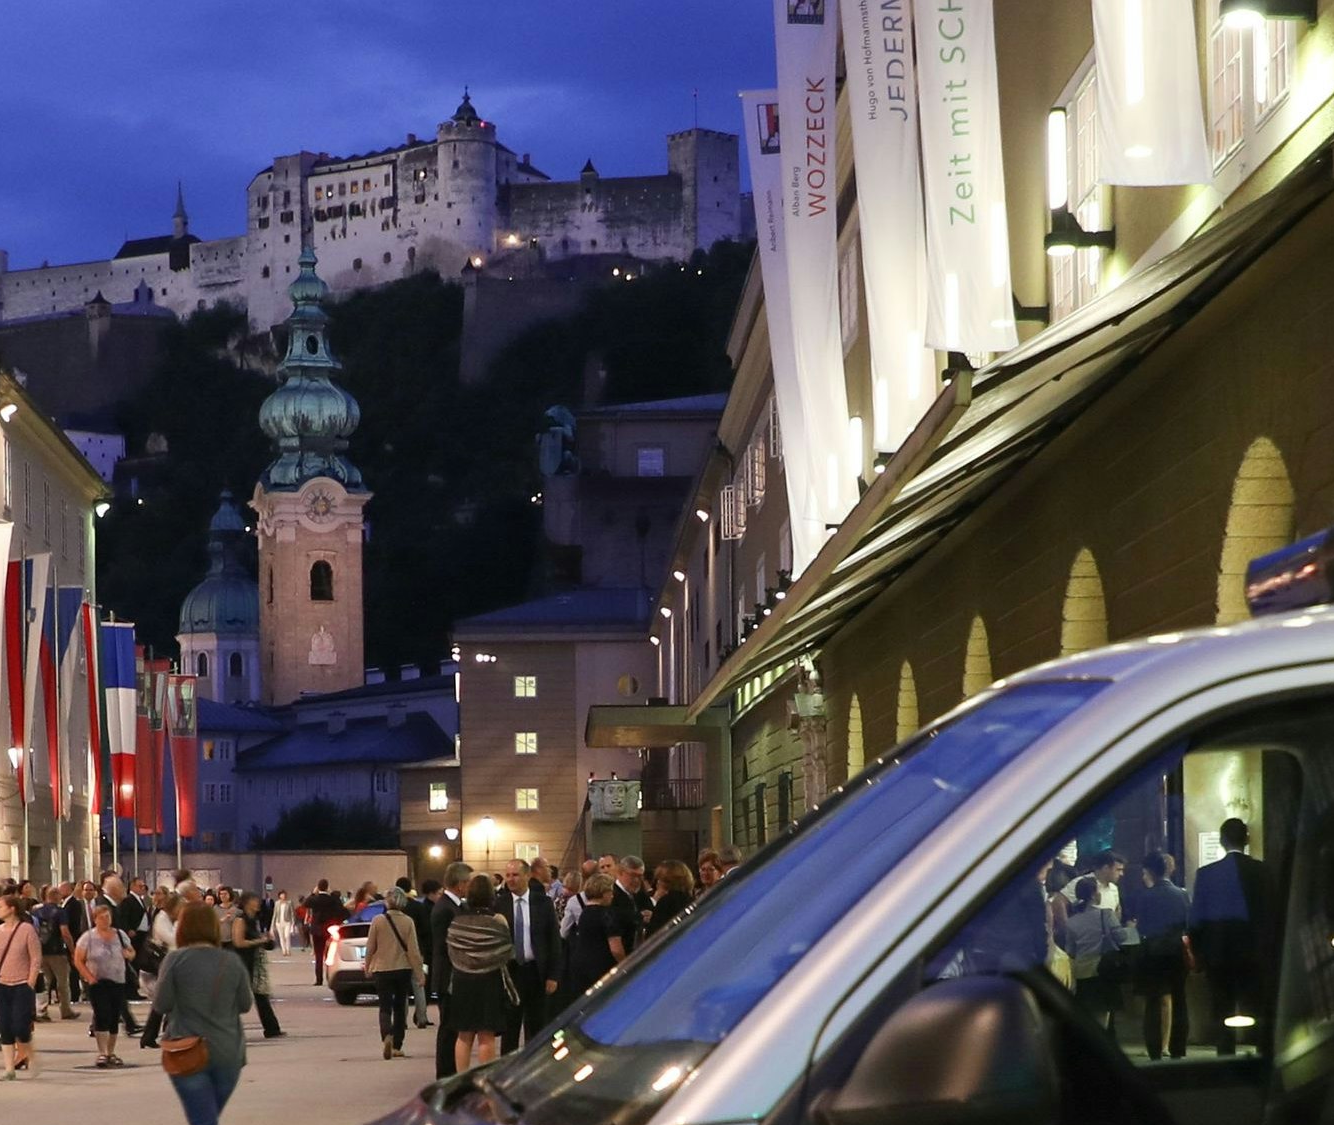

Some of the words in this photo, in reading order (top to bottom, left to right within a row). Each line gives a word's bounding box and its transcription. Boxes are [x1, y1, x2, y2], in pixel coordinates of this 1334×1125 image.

[865, 68, 875, 88] von
[867, 91, 878, 120] Hugo
[942, 79, 970, 137] mit
[805, 77, 827, 217] WOZZECK
[791, 166, 801, 189] Berg
[947, 153, 976, 226] Zeit
[791, 190, 800, 217] Alban
